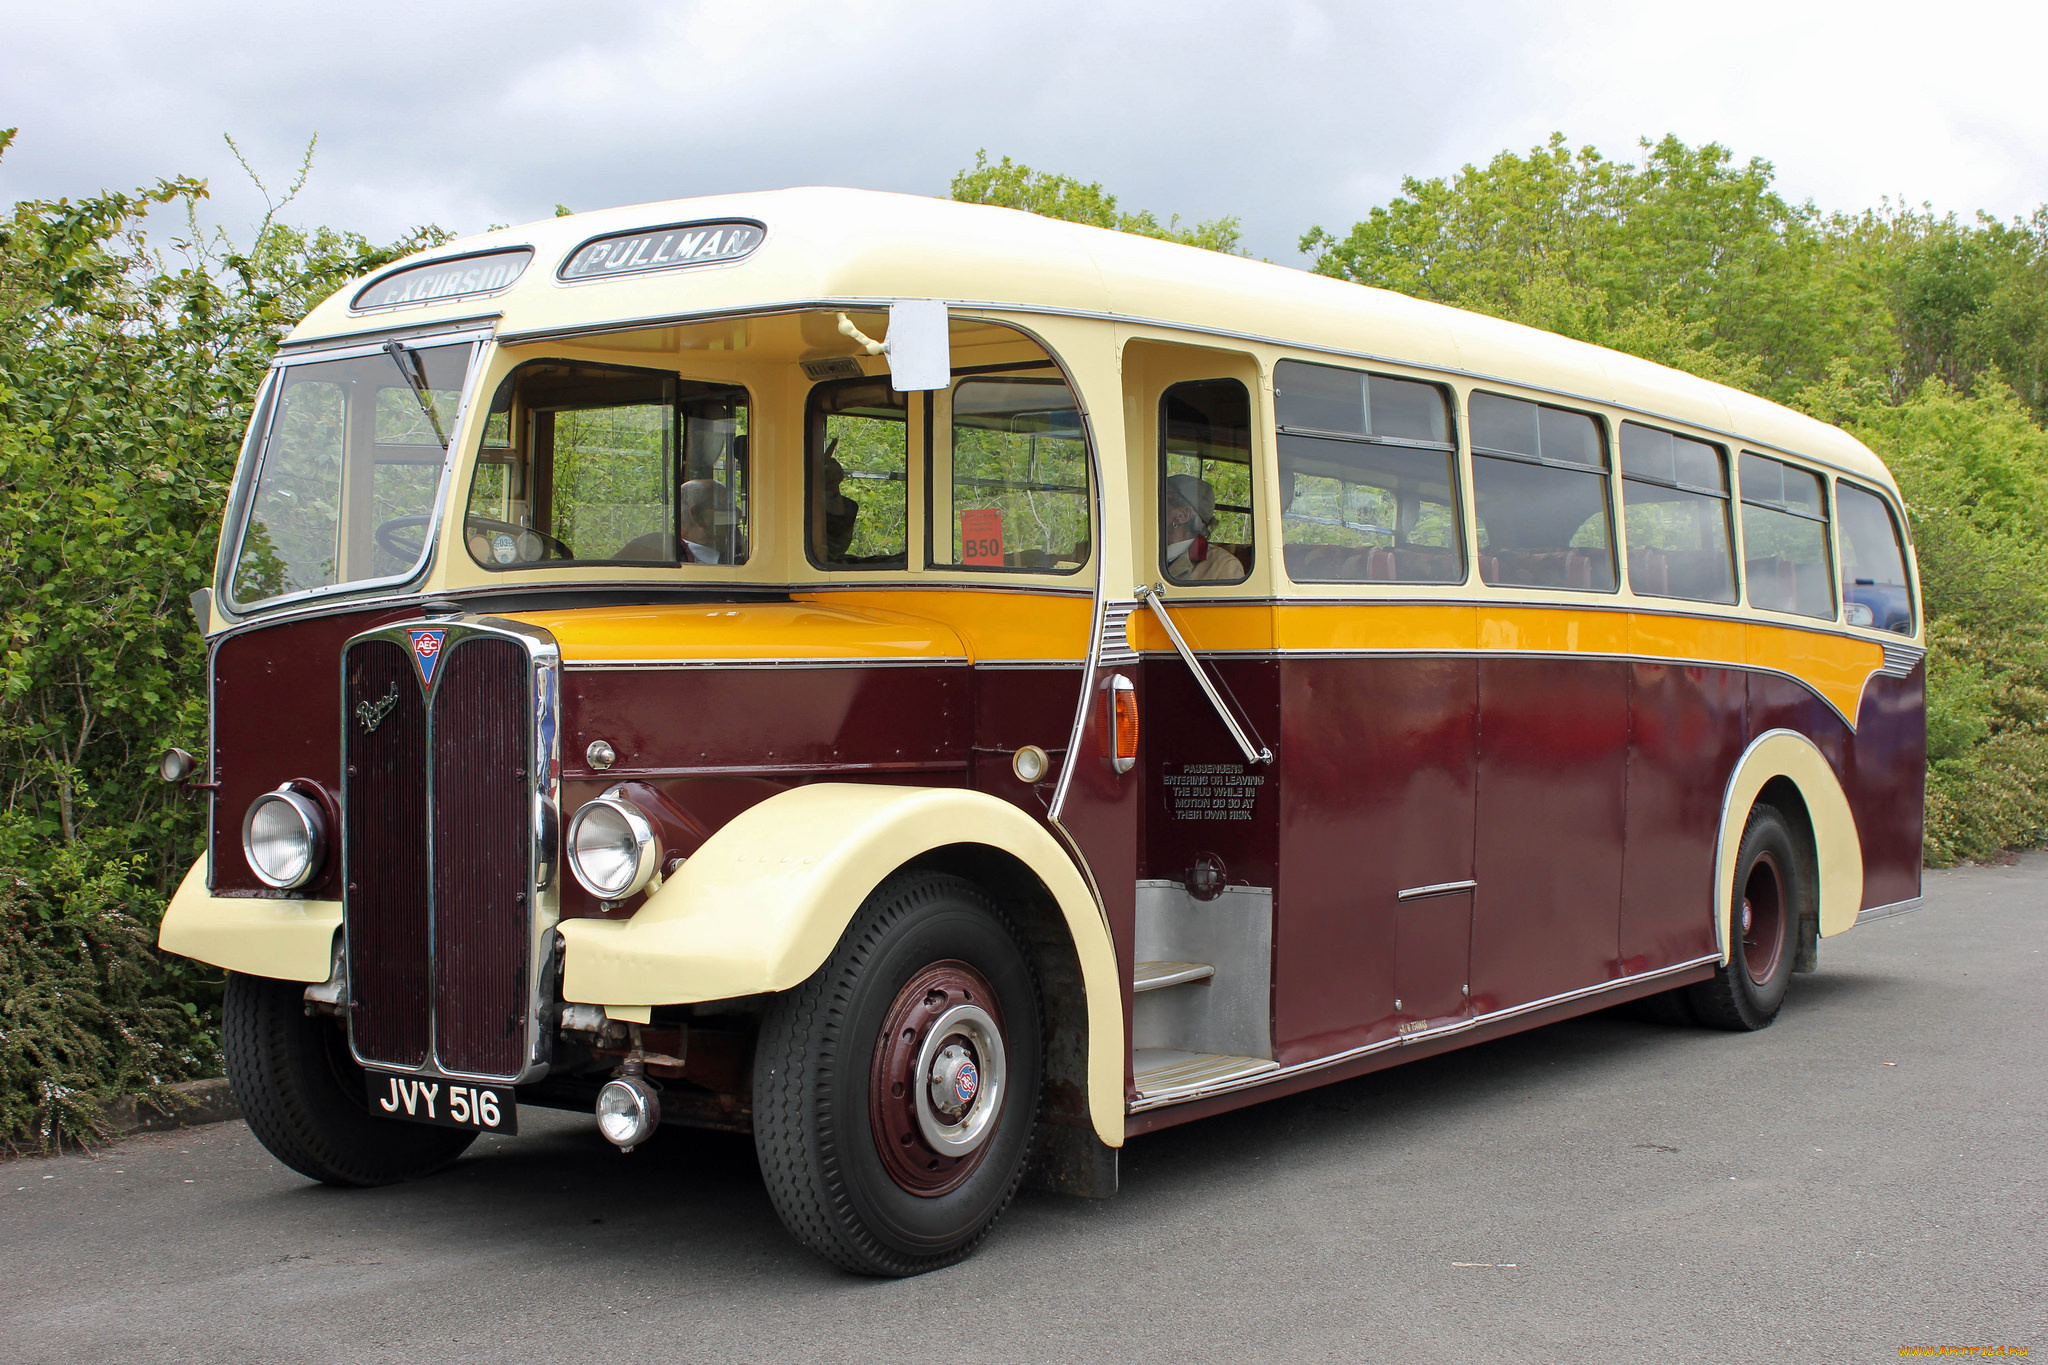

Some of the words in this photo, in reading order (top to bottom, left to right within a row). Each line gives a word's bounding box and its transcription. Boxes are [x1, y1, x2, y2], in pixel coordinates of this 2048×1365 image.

[580, 230, 750, 271] PULLMAN
[966, 538, 998, 557] B50
[417, 640, 438, 650] AEC
[1183, 764, 1244, 774] PASSENGERS
[1163, 776, 1208, 786] ENTERING
[1210, 776, 1223, 786] OR
[1225, 776, 1265, 786] LEAVING
[1173, 787, 1191, 797] THE
[1192, 787, 1212, 797] BUS
[1214, 787, 1243, 797] WHILE
[1245, 787, 1256, 797] IN
[1175, 798, 1211, 808] MOTION
[1212, 798, 1226, 808] DO
[1227, 798, 1241, 808] SO
[1241, 798, 1255, 808] AT
[1176, 810, 1202, 820] THEIR
[1204, 810, 1227, 820] OWN
[1228, 810, 1252, 820] RISK
[380, 1078, 439, 1118] JVY
[449, 1086, 500, 1127] 516
